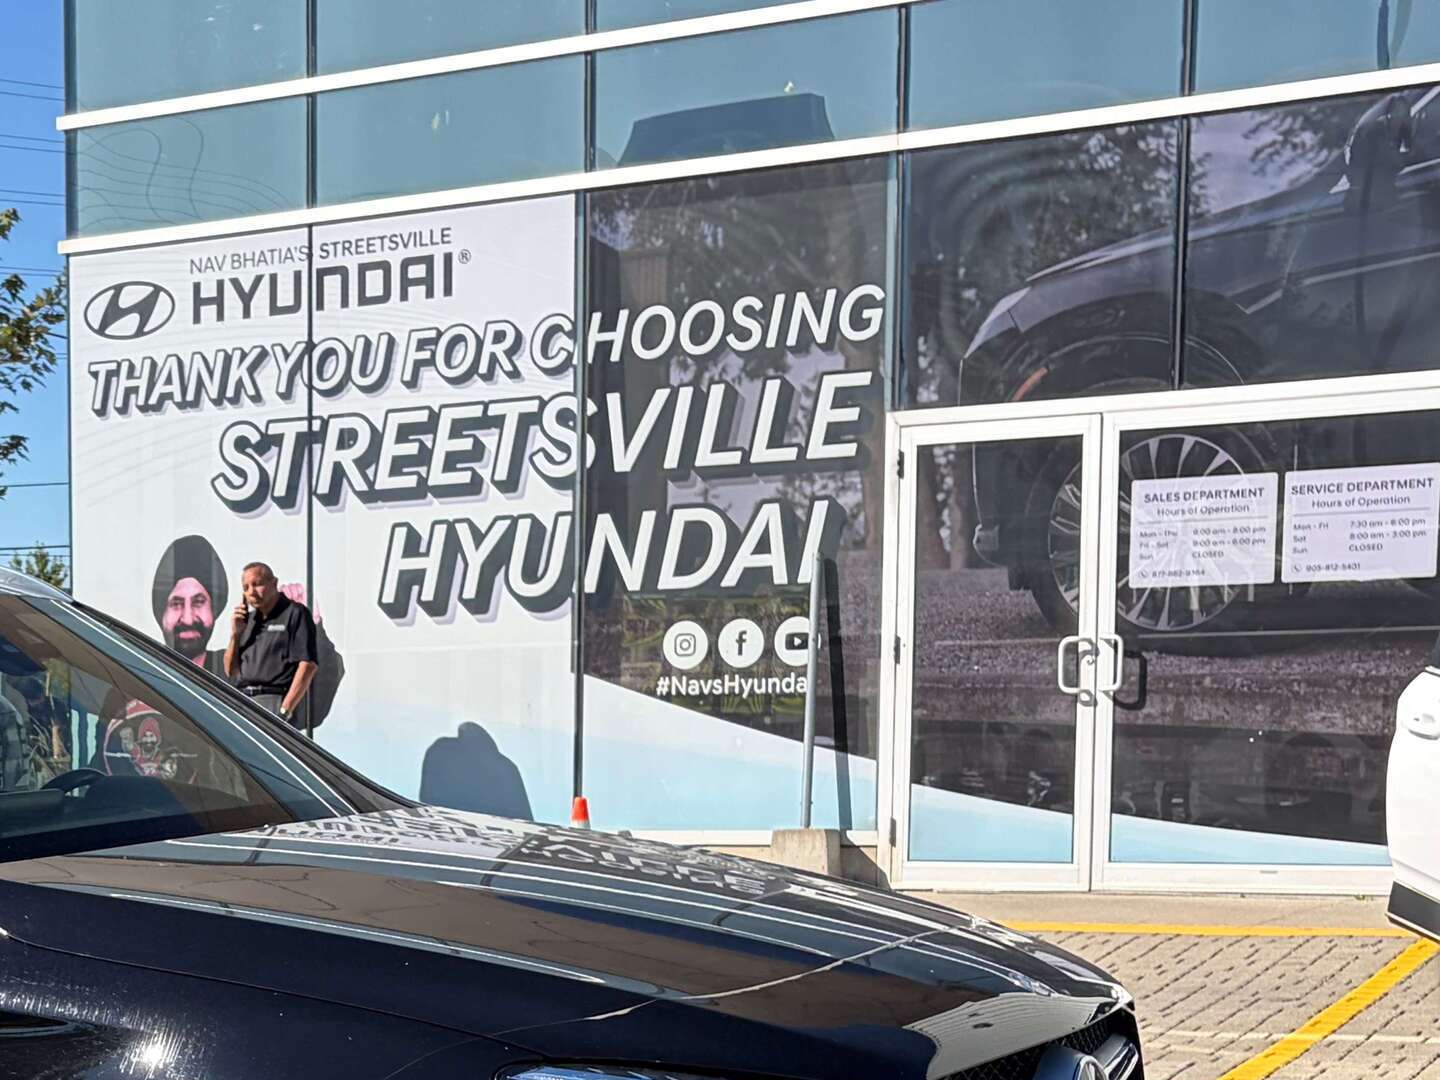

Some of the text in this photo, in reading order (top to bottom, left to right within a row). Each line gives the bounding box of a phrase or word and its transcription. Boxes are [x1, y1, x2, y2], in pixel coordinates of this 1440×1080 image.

[190, 227, 452, 275] NAV BHATIA'S STREETSVILLE
[192, 252, 453, 325] HYUNDAI
[88, 283, 886, 419] THANK YOU FOR CHOOSING
[212, 370, 873, 511] STREETSVILLE
[1144, 487, 1265, 504] SALES DEPARTMENT
[1291, 477, 1435, 496] SERVICE DEPARTMENT
[1157, 503, 1250, 517] Hours of Operation
[1311, 495, 1411, 509] Hours of Operation
[1412, 518, 1426, 528] pm
[1412, 530, 1427, 540] pm
[1192, 550, 1225, 559] CLOSED
[1348, 543, 1383, 552] CLOSED
[378, 499, 844, 619] HYUNDAI
[656, 672, 808, 699] #NavsHyunda
